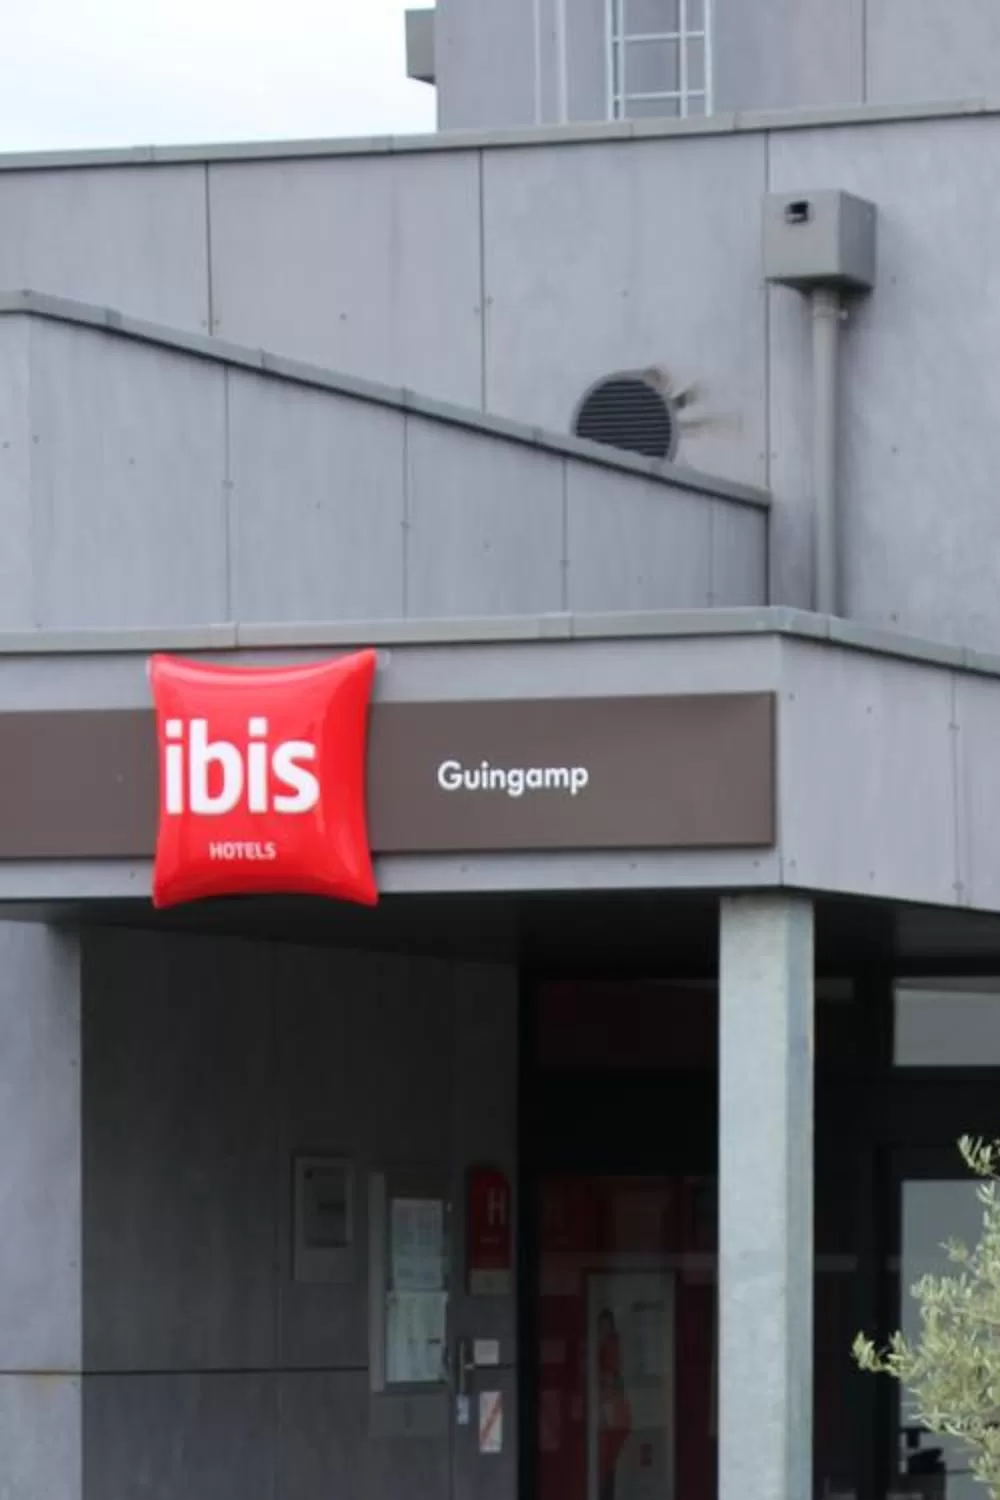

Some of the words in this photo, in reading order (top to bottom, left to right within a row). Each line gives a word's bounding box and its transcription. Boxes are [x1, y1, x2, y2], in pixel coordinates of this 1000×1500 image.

[165, 716, 320, 815] ibis
[437, 760, 589, 797] Guingamp
[209, 841, 276, 860] HOTELS
